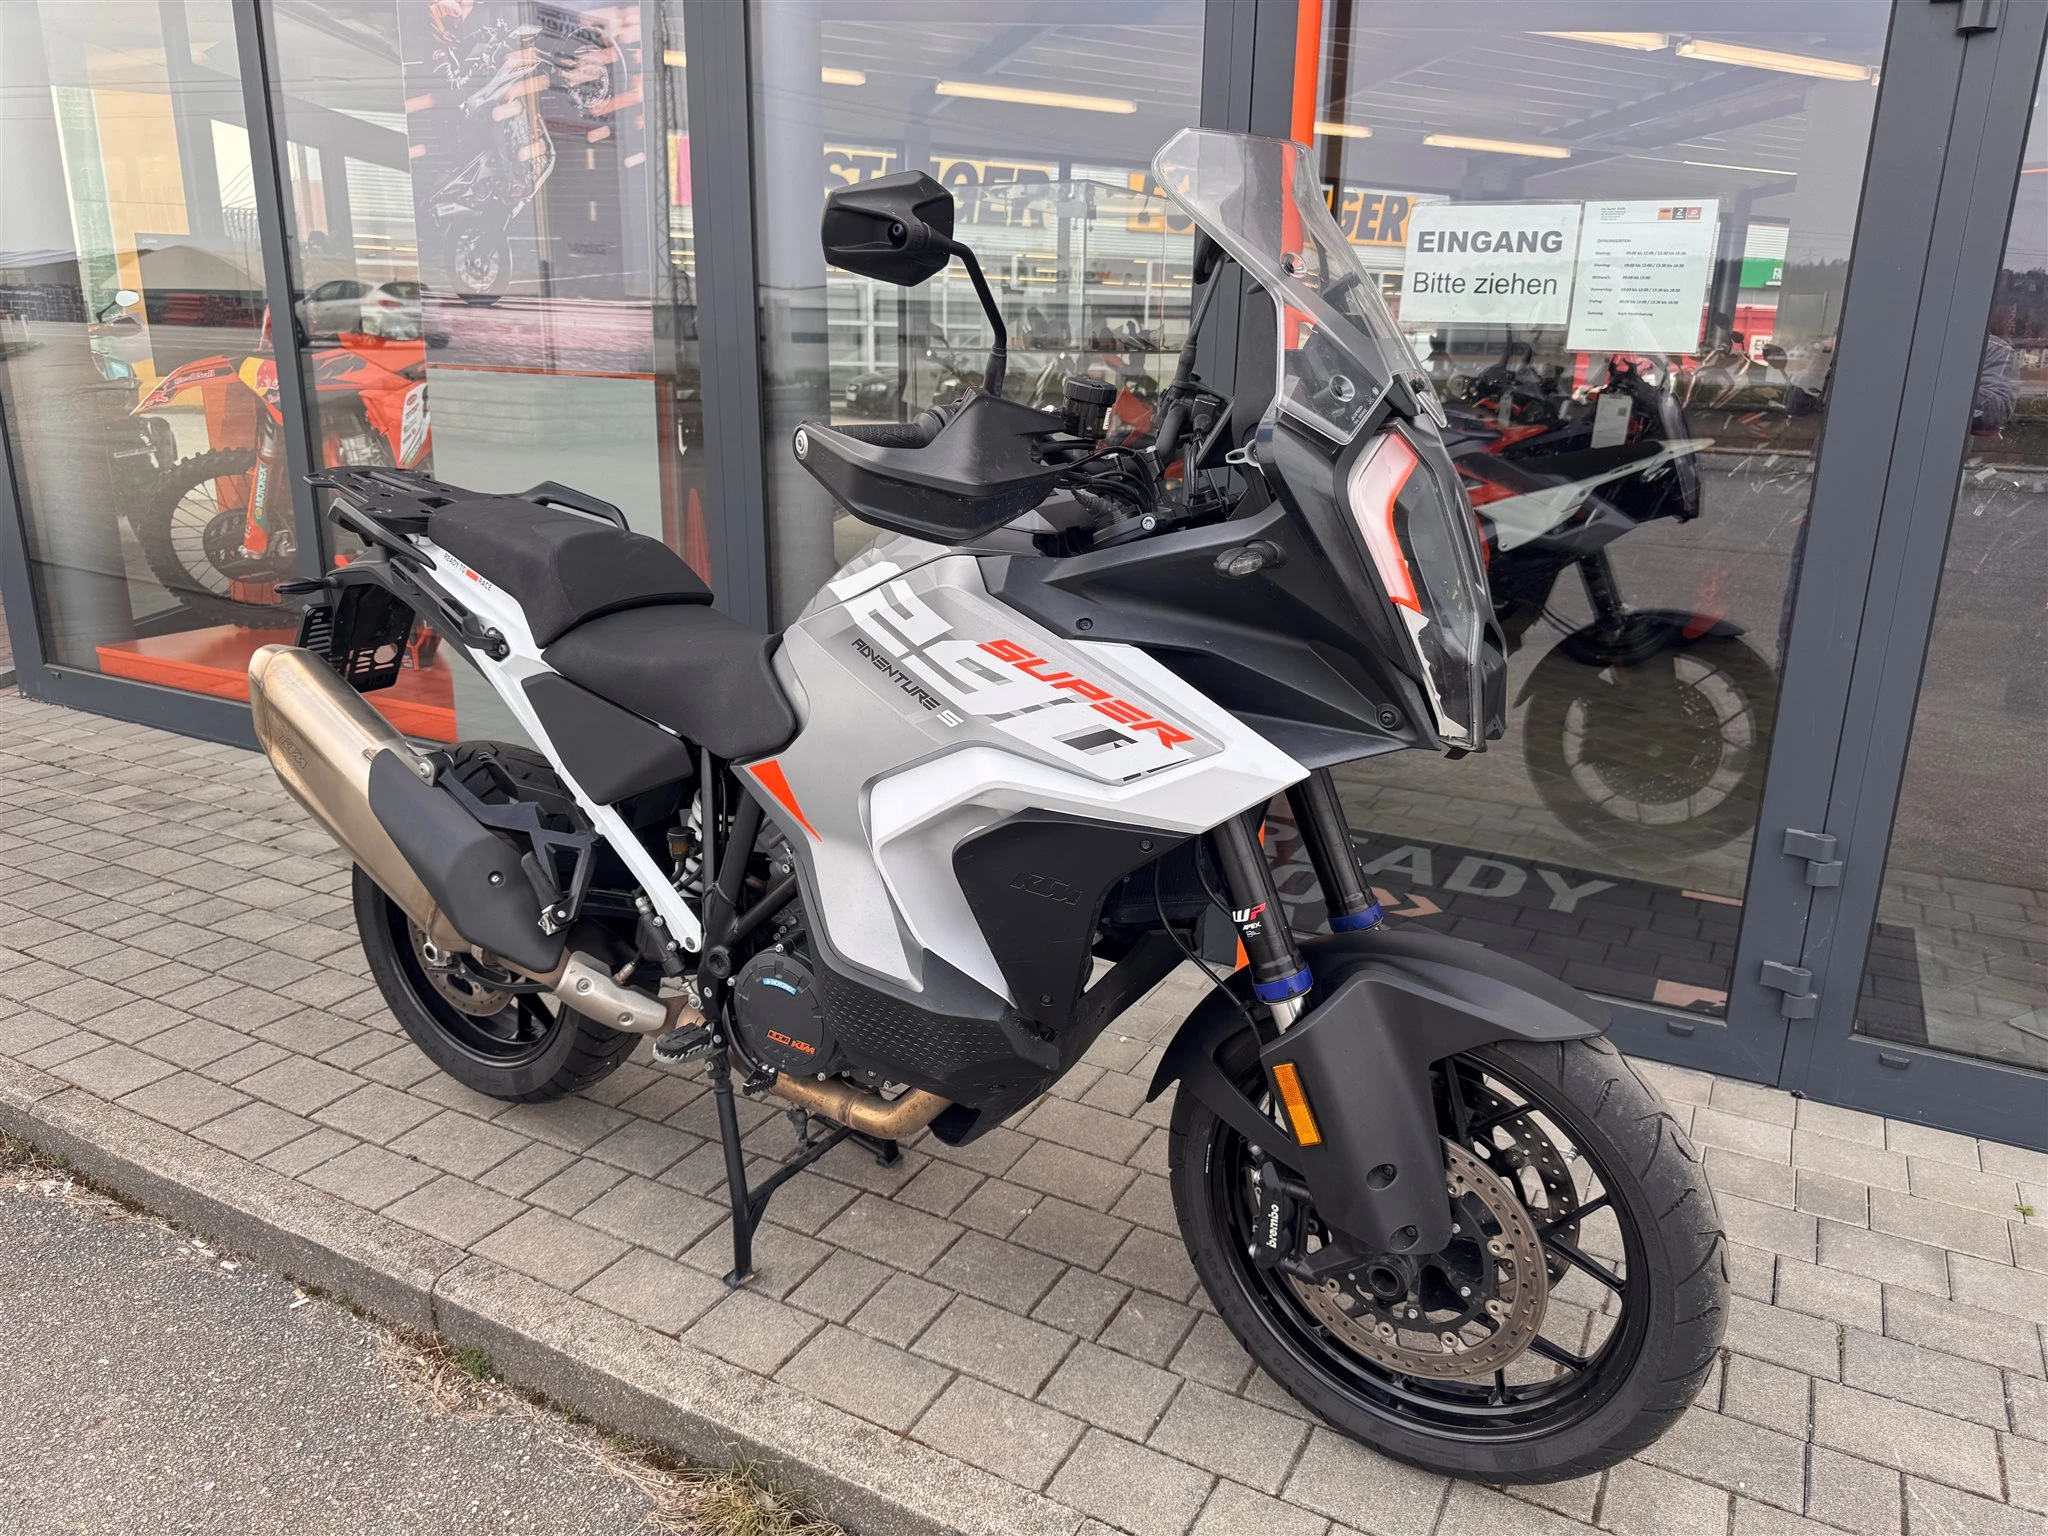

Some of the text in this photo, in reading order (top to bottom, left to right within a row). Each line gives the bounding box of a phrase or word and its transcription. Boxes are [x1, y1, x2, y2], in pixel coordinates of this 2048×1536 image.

[1416, 230, 1563, 253] EINGANG
[1412, 271, 1558, 295] Bitte ziehen
[443, 552, 493, 591] READY TO RACE
[850, 637, 965, 728] ADVENTURE S
[976, 638, 1195, 751] SUPER
[1242, 921, 1262, 931] APEX
[791, 1039, 816, 1055] KTM
[1265, 1203, 1280, 1249] brembo
